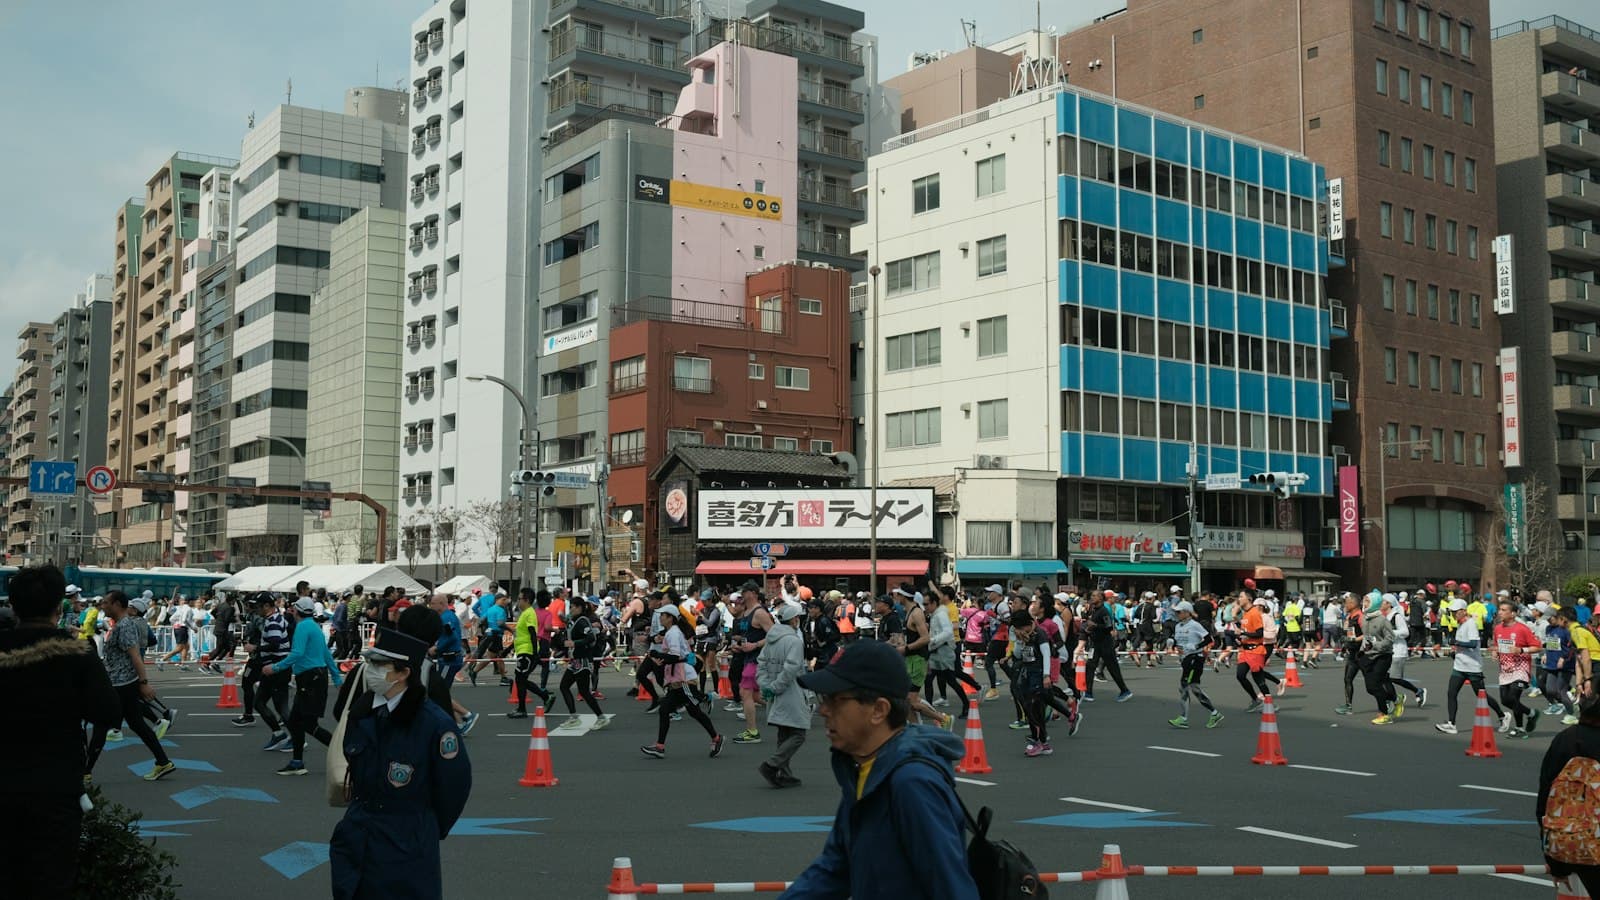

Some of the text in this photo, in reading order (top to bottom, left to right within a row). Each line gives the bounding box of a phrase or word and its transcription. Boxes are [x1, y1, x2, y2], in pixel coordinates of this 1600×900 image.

[1500, 265, 1511, 309] 公証役場
[1503, 372, 1517, 453] 岡三証券
[707, 500, 924, 528] 喜多方 坂内 ラーメン
